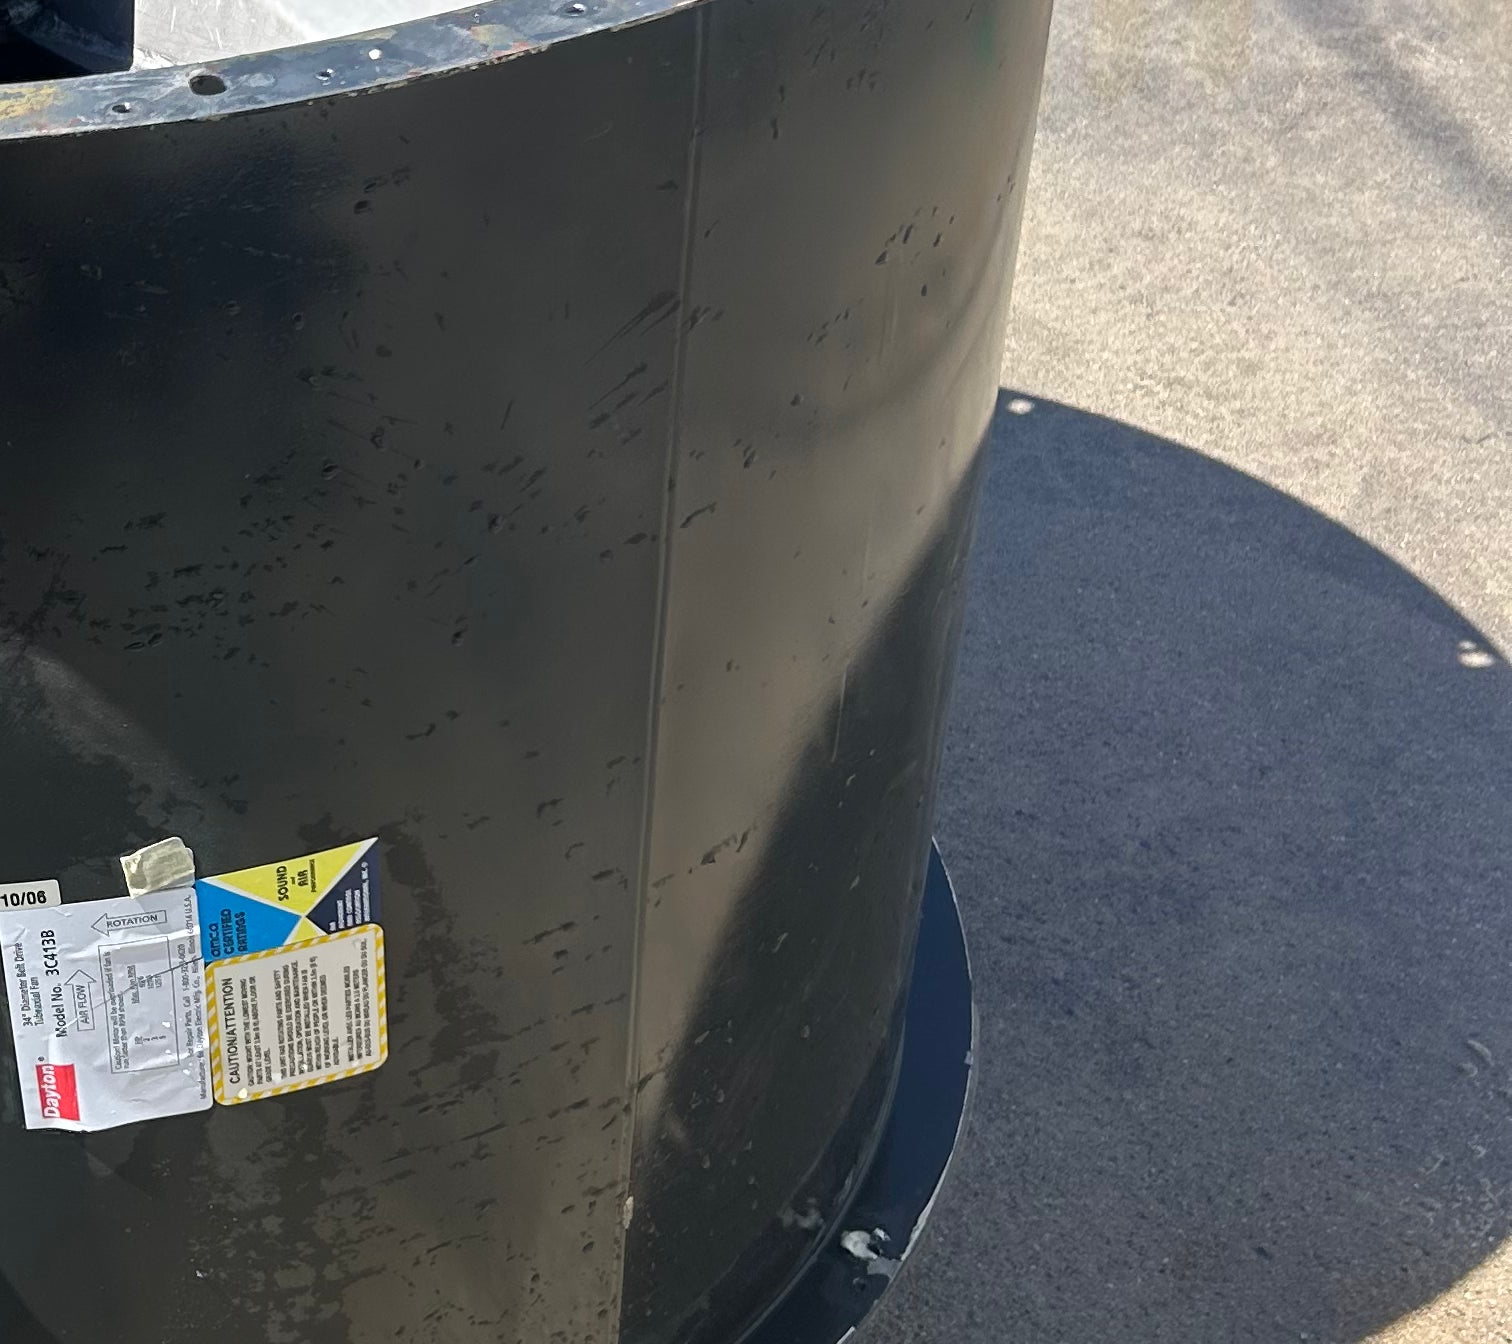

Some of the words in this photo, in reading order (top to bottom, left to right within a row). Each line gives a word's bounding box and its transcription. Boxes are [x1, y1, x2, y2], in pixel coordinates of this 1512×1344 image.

[276, 866, 289, 902] SOUND
[297, 870, 308, 887] AIR
[0, 890, 47, 907] 10/06
[107, 914, 158, 928] ROTATION
[220, 909, 235, 954] CERTIFIED
[234, 912, 248, 952] RATINGS
[13, 942, 24, 961] Drive
[41, 930, 59, 976] 3C413B
[209, 923, 221, 956] amca
[15, 963, 26, 978] Belt
[29, 977, 39, 990] Fan
[19, 980, 30, 1011] Diameter
[51, 984, 62, 1001] No.
[76, 985, 86, 1008] FLOW
[31, 992, 44, 1026] Tubeaxial
[50, 1004, 68, 1038] Model
[77, 1010, 89, 1024] AIR
[221, 978, 240, 1084] CAUTION/ATTENTION
[41, 1065, 62, 1118] Dayton
